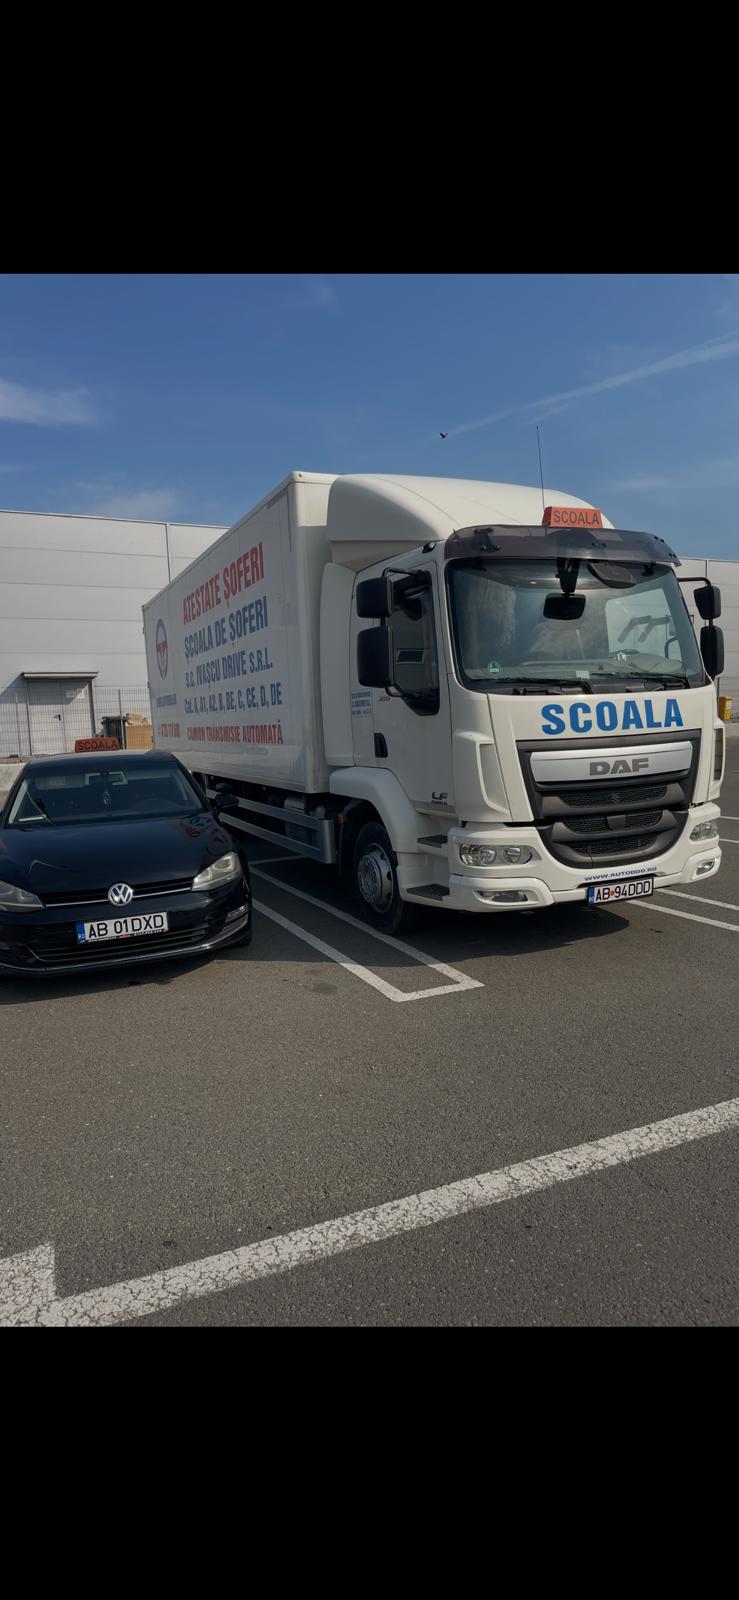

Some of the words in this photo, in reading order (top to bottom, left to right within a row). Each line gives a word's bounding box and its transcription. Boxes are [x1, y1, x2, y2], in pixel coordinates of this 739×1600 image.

[553, 510, 600, 525] SCOALA
[223, 542, 265, 609] ȘOFERI
[183, 577, 221, 625] ATESTATE
[216, 620, 227, 646] DE
[229, 596, 268, 648] ȘOFERI
[186, 671, 196, 689] S.C.
[222, 650, 247, 680] DRIVE
[249, 648, 273, 673] S.R.L.
[226, 691, 237, 712] BE,
[238, 690, 245, 712] C,
[246, 687, 259, 710] CE,
[261, 685, 269, 710] D,
[270, 682, 282, 705] DE
[541, 697, 684, 735] SCOALA
[187, 726, 206, 742] CAMION
[206, 725, 241, 743] TRANSMISIE
[242, 720, 284, 745] AUTOMATĂ
[78, 740, 118, 752] SCOALA
[589, 757, 649, 776] DAF
[432, 792, 448, 800] LF
[595, 887, 611, 902] AB
[89, 922, 108, 938] AB
